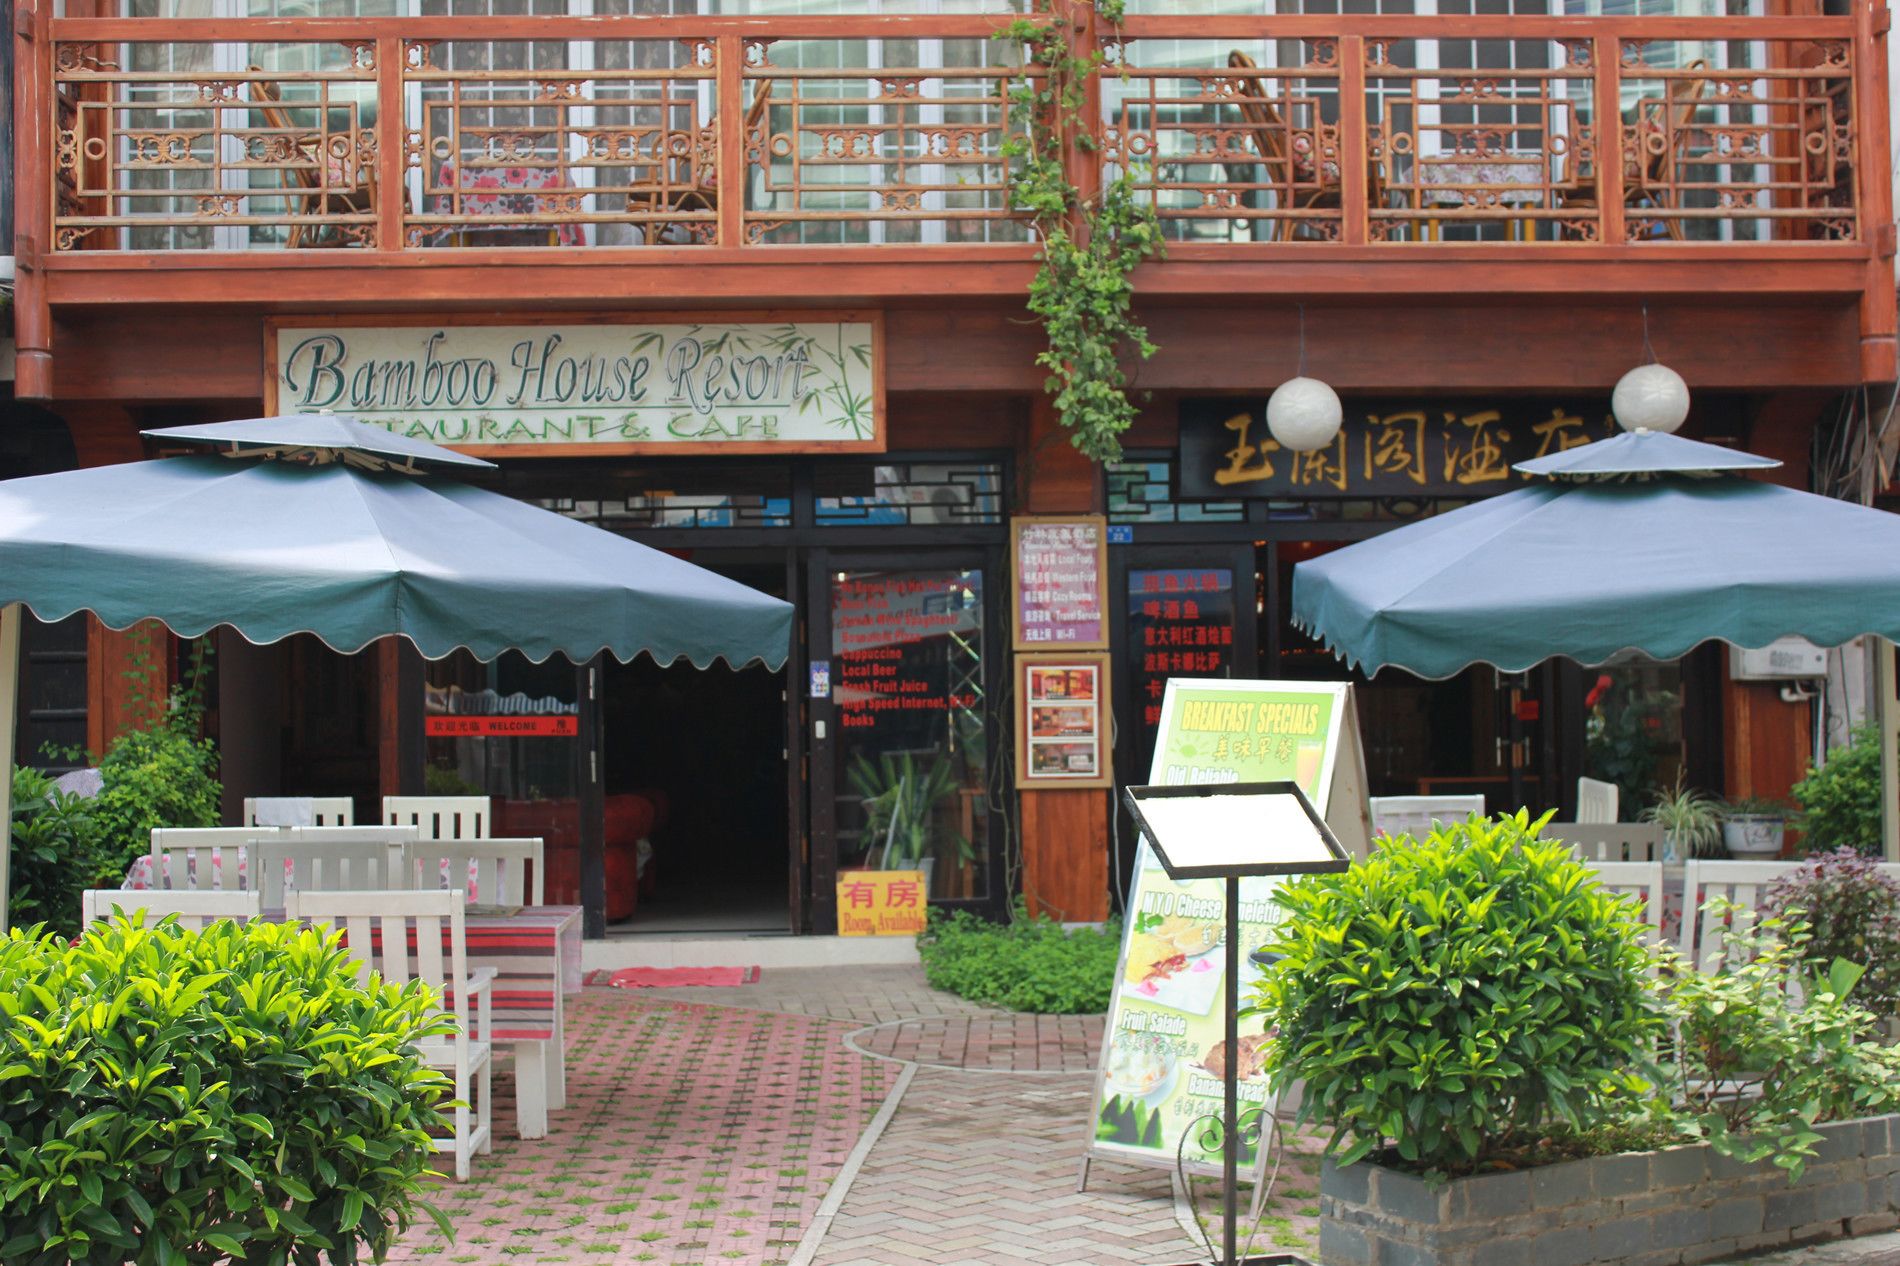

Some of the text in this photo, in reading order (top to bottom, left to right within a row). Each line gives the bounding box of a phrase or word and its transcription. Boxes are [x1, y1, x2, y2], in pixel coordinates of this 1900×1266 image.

[286, 330, 809, 414] Bamboo House Resort
[620, 411, 650, 438] &
[1058, 555, 1075, 565] Local
[1056, 610, 1076, 621] Travel
[842, 649, 903, 662] Cappuccino
[842, 664, 897, 677] Local Beer
[842, 680, 928, 692] Fresh Fruit Juice
[842, 697, 866, 713] High
[869, 697, 899, 713] Speed
[902, 696, 948, 712] Internet,
[488, 721, 537, 731] WELCOME
[842, 713, 875, 726] Books
[1182, 700, 1319, 735] BREAKFAST SPECIALS
[1166, 764, 1239, 784] Old Reliable
[843, 880, 920, 909] 有房
[1176, 893, 1223, 920] Cheese
[1122, 1009, 1147, 1031] Fruit
